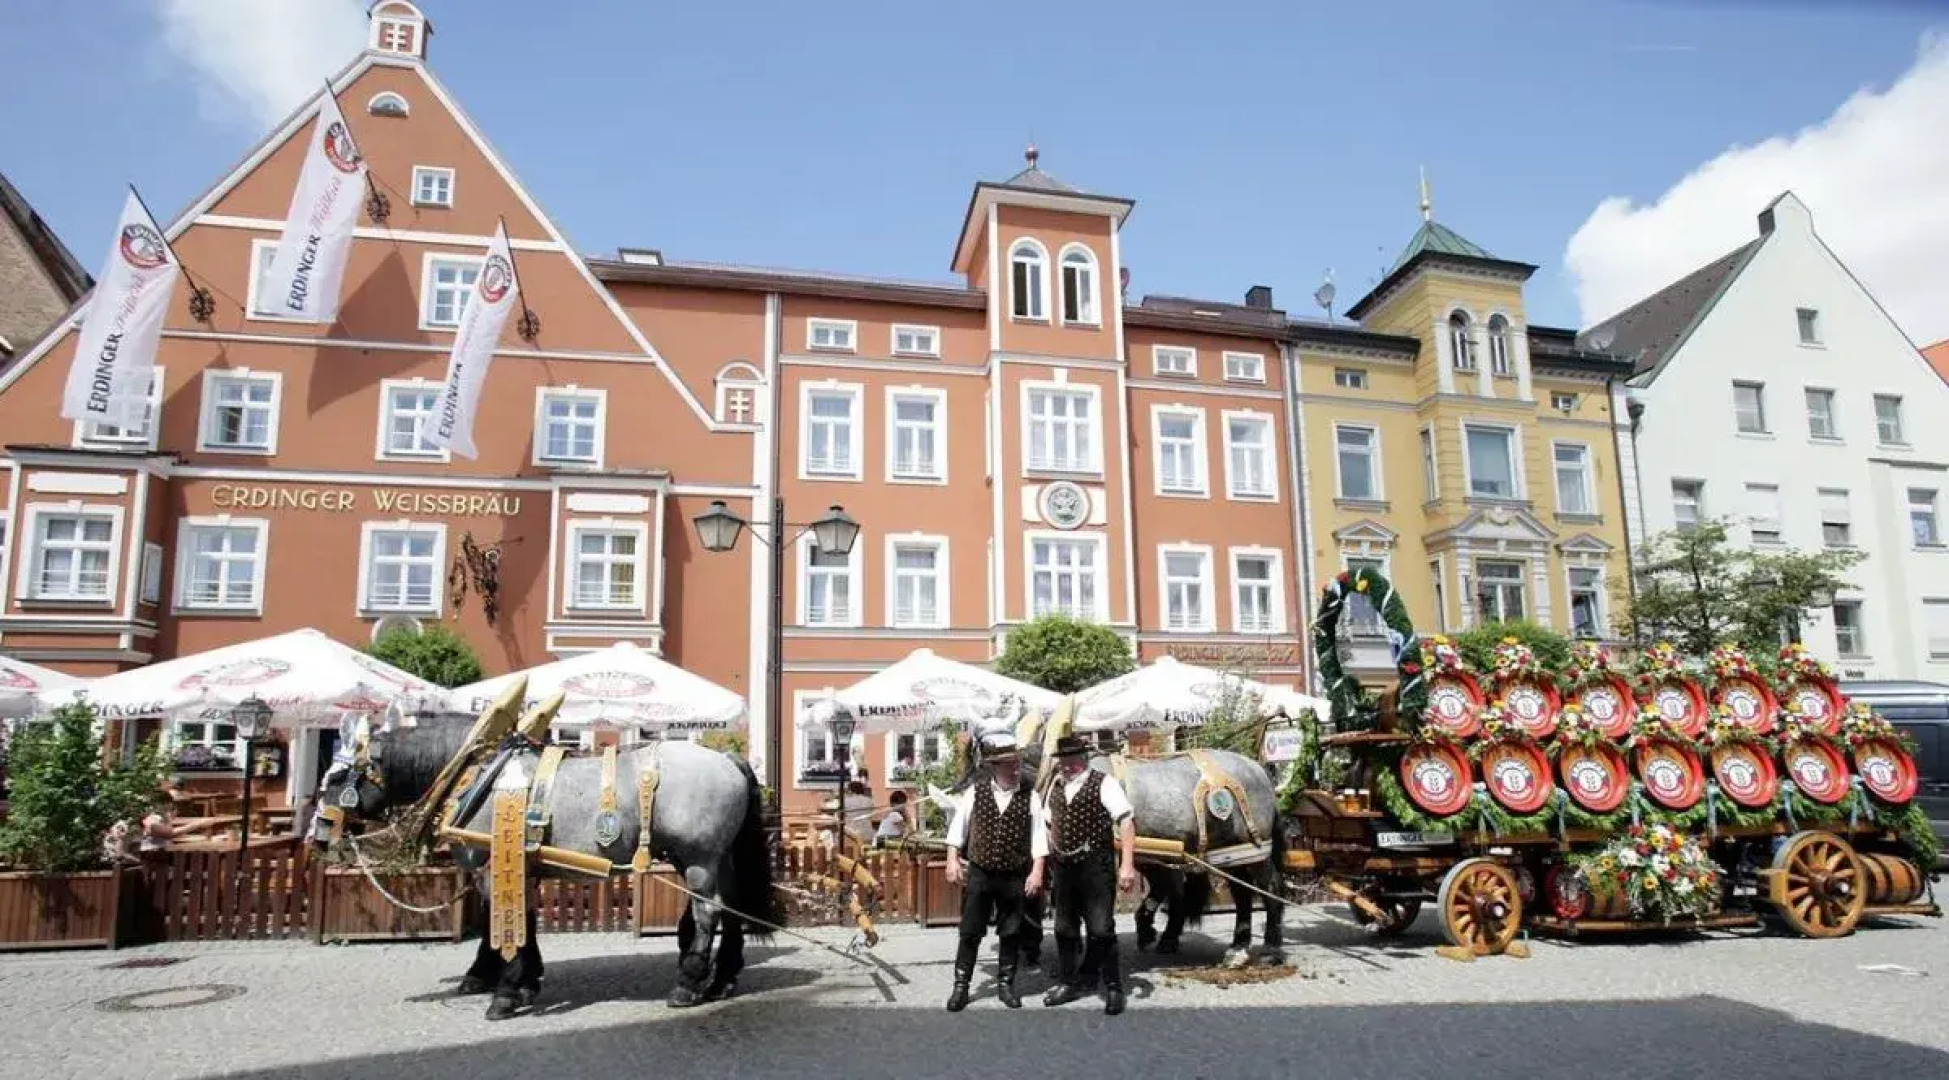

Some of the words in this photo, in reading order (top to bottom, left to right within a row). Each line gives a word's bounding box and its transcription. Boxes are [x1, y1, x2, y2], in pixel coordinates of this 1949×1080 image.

[286, 234, 322, 311] ERDINGER
[87, 332, 124, 414] ERDINGER
[212, 485, 355, 511] ERDINGER
[373, 488, 521, 516] WEISSBRÄU
